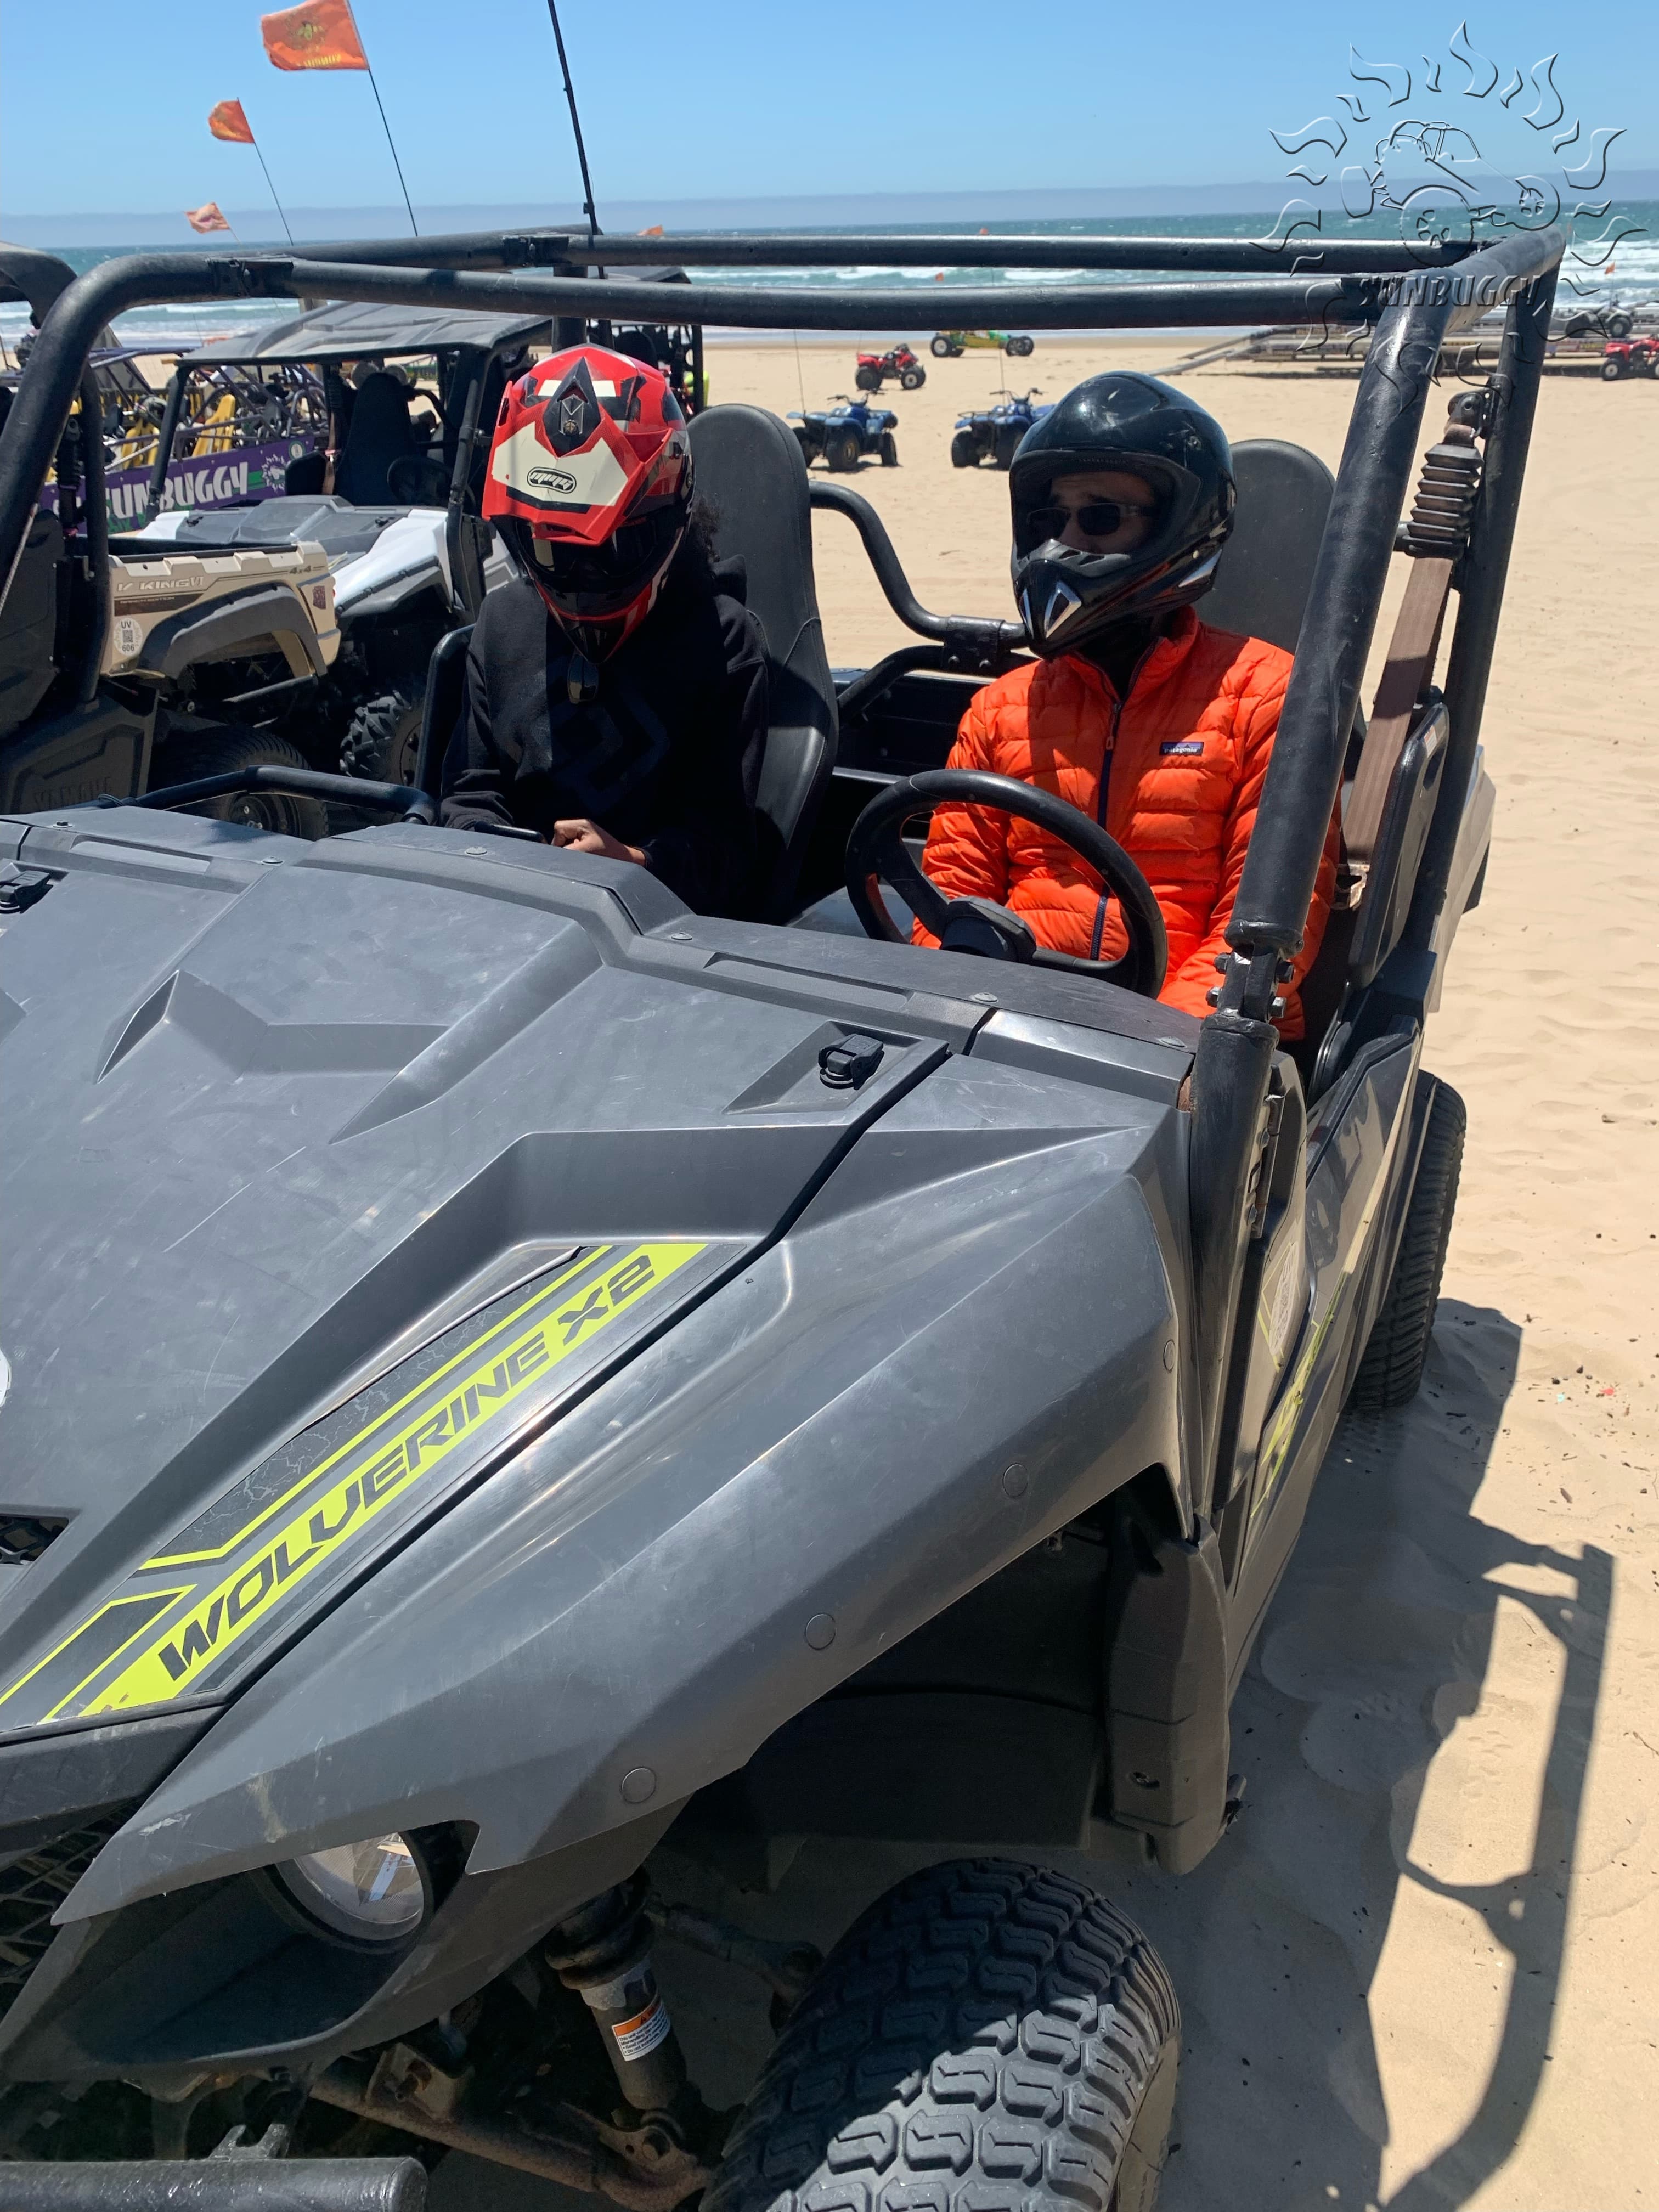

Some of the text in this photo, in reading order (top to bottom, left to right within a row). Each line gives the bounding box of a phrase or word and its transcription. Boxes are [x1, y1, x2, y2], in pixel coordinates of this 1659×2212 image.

[105, 462, 249, 520] UNBUGGY
[158, 1255, 656, 1682] WOLVERINE X2
